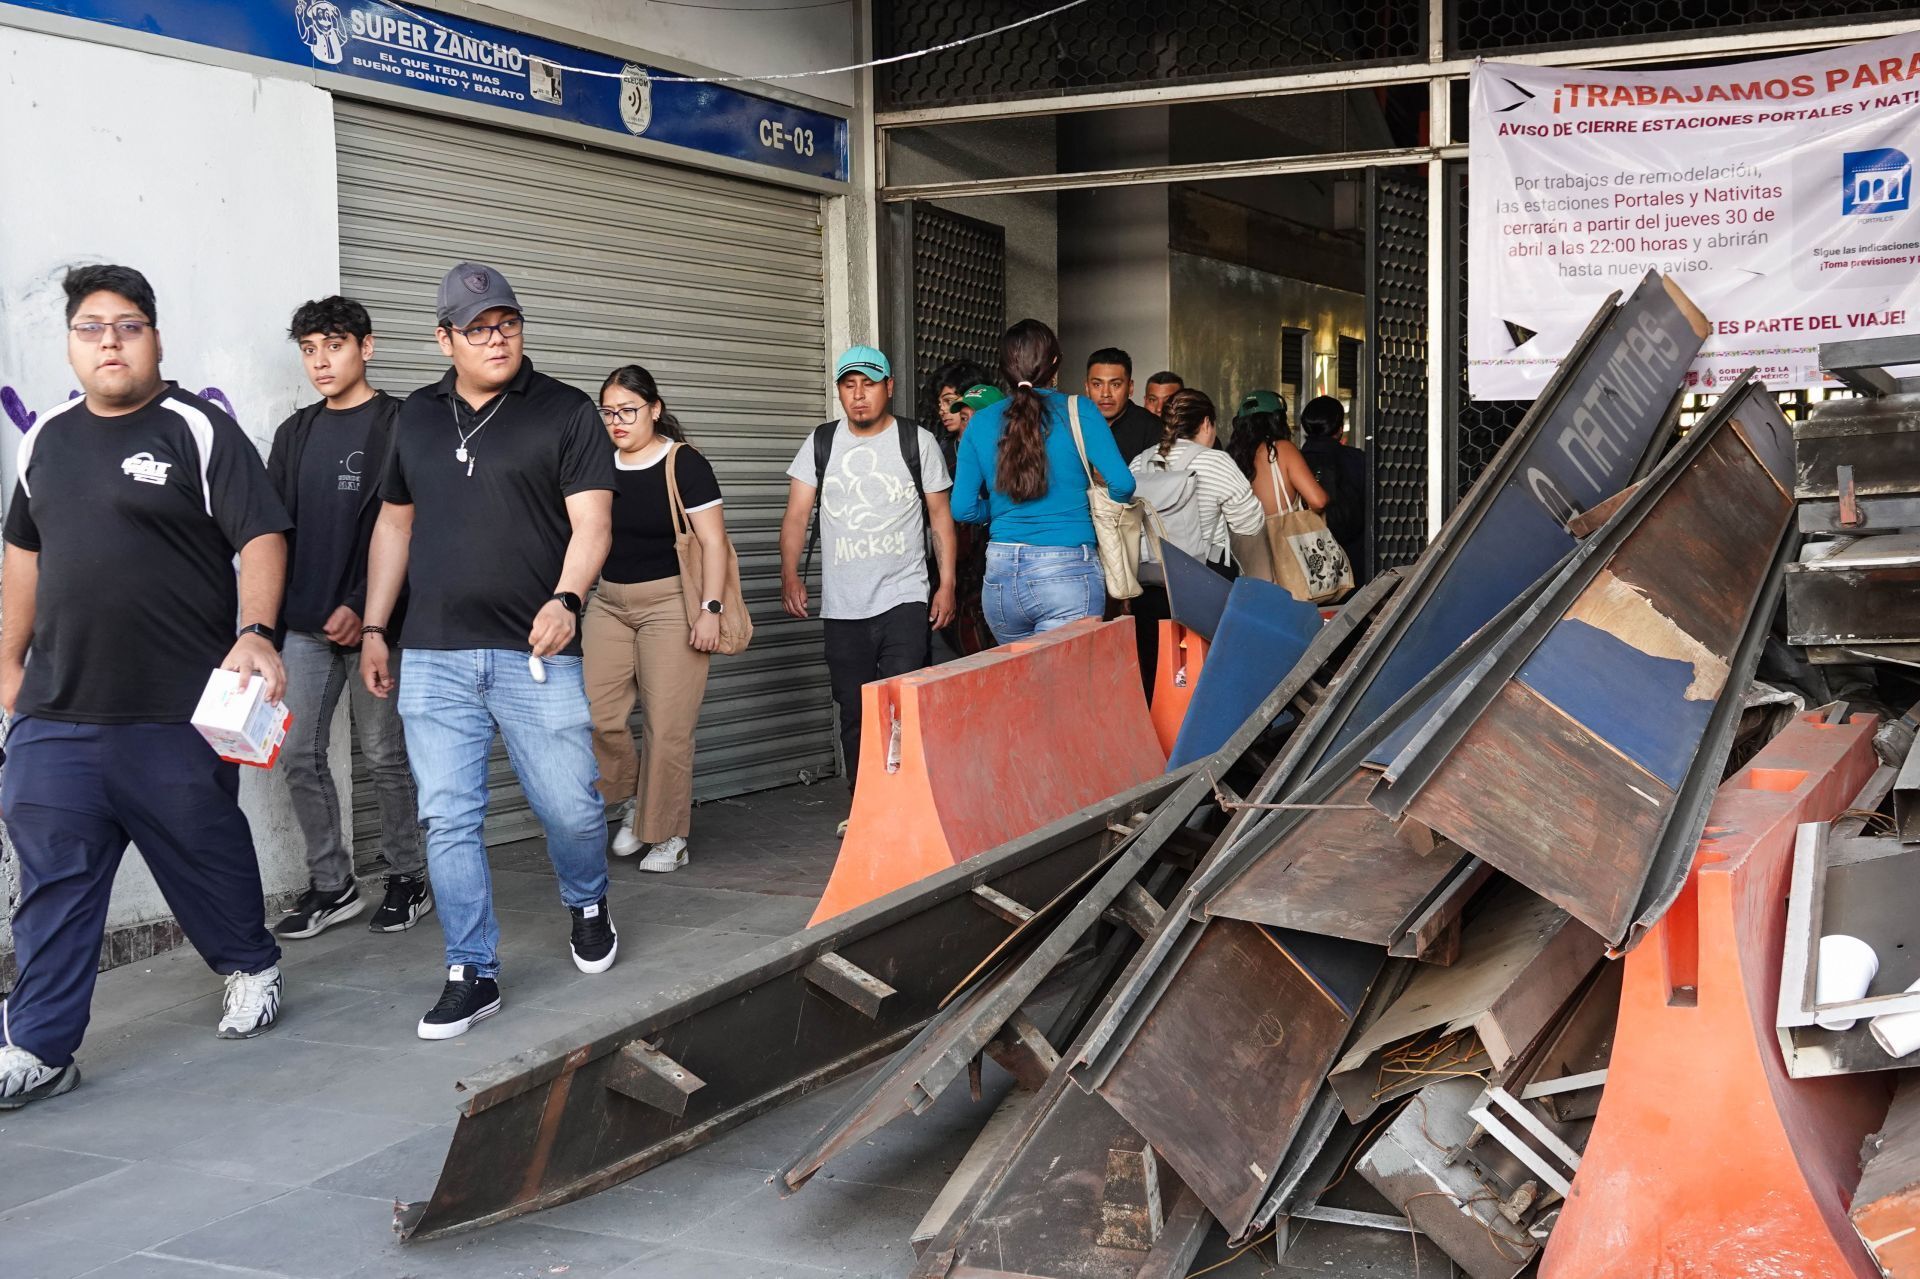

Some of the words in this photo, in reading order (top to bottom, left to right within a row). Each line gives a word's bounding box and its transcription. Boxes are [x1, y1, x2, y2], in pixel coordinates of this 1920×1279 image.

[351, 9, 427, 51] SUPER
[433, 29, 523, 72] ZANCHO
[352, 57, 401, 75] BUENO
[405, 69, 458, 87] BONITO
[461, 81, 470, 90] Y
[474, 84, 525, 101] BARATO
[379, 52, 396, 63] EL
[401, 57, 430, 71] QUE
[433, 64, 469, 79] TEDA
[472, 73, 500, 86] MAS
[1553, 75, 1815, 114] ¡TRABAJAMOS
[1499, 122, 1549, 137] AVISO
[1553, 122, 1572, 137] DE
[1576, 120, 1638, 134] CIERRE
[1642, 115, 1753, 132] ESTACIONES
[1758, 103, 1853, 123] PORTALES
[1859, 99, 1871, 111] Y
[759, 119, 814, 157] CE-03
[1515, 176, 1539, 190] Por
[1544, 173, 1609, 191] trabajos
[1614, 172, 1634, 186] de
[1639, 162, 1762, 184] remodelación,
[1496, 199, 1519, 214] las
[1524, 196, 1609, 212] estaciones
[1614, 190, 1684, 208] Portales
[1689, 192, 1699, 208] y
[1704, 185, 1782, 203] Nativitas
[1503, 218, 1567, 235] cerrarán
[1573, 221, 1582, 232] a
[1587, 216, 1630, 234] partir
[1635, 214, 1660, 230] del
[1664, 213, 1720, 232] jueves
[1726, 209, 1747, 224] 30
[1753, 207, 1775, 222] de
[1509, 241, 1543, 257] abril
[1548, 244, 1556, 256] a
[1561, 240, 1584, 255] las
[1590, 237, 1636, 254] 22:00
[1641, 236, 1688, 252] horas
[1693, 237, 1702, 252] y
[1707, 230, 1768, 249] abrirán
[1813, 248, 1840, 258] Sigue
[1843, 246, 1856, 254] las
[1858, 241, 1920, 253] indicaciones
[1559, 262, 1602, 277] hasta
[1608, 262, 1658, 276] nuevo
[1663, 258, 1713, 273] aviso.
[1851, 256, 1907, 268] previsiones
[1909, 255, 1916, 264] y
[1718, 320, 1739, 335] ES
[1744, 317, 1804, 334] PARTE
[1809, 315, 1842, 330] DEL
[1847, 310, 1906, 328] VIAJE!
[1719, 367, 1762, 375] GOBIEO
[834, 531, 906, 565] Mickey
